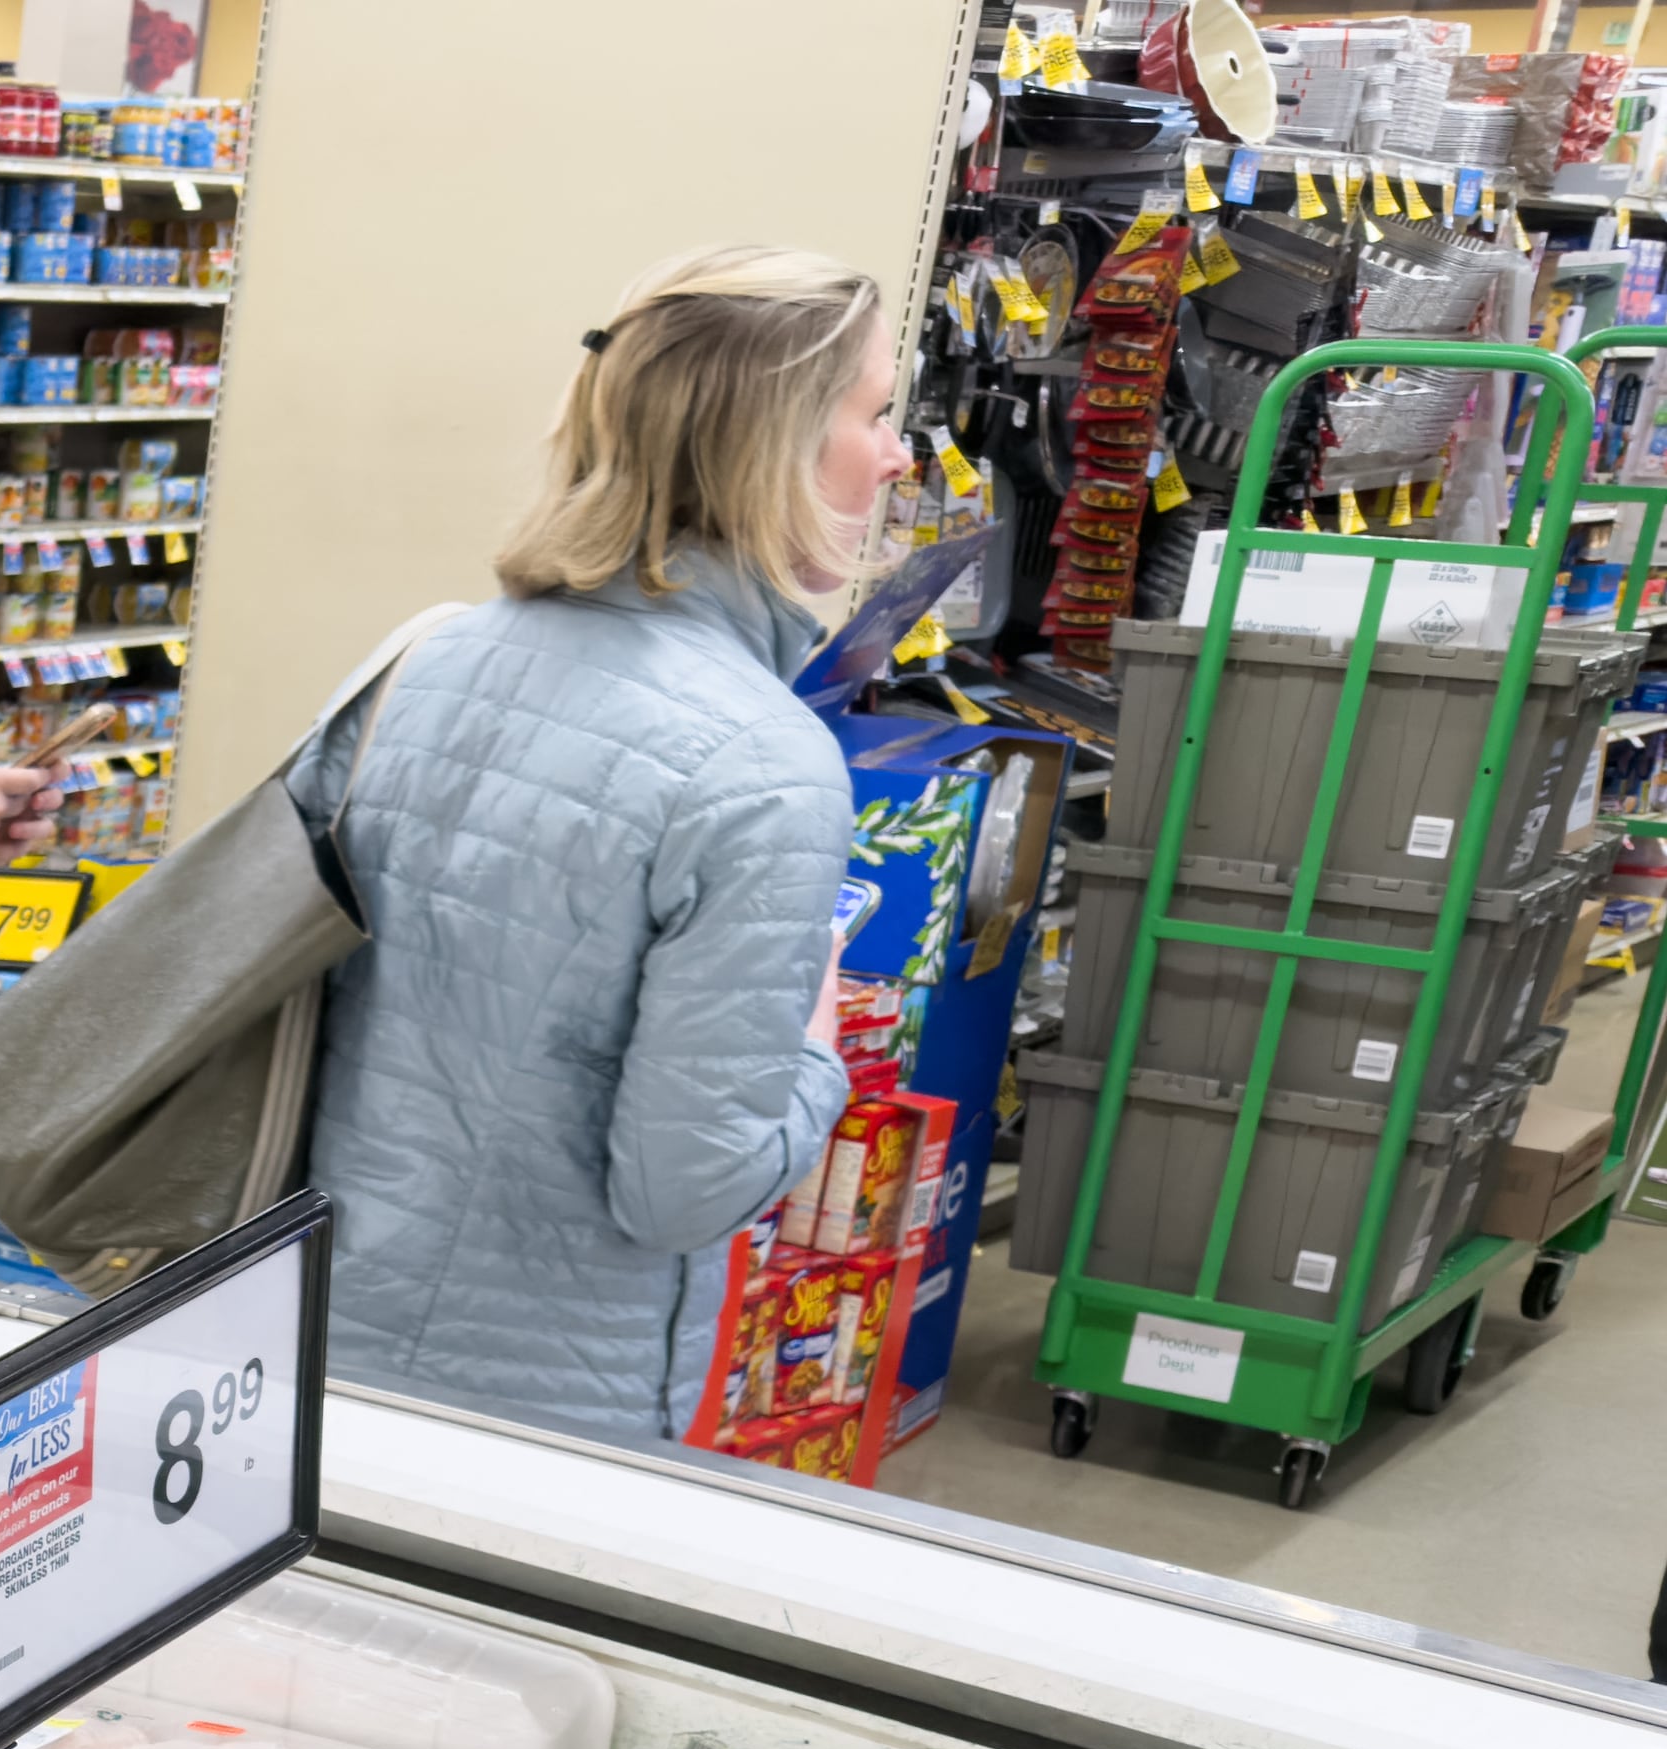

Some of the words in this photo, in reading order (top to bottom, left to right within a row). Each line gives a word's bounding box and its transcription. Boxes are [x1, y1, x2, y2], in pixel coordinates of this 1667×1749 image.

[1148, 1330, 1220, 1358] Produce
[27, 1369, 72, 1418] BEST
[6, 1452, 30, 1496] for
[30, 1418, 72, 1468] LESS
[244, 1456, 255, 1472] lb
[11, 1492, 38, 1523] More
[41, 1482, 58, 1503] on
[60, 1466, 79, 1492] our
[28, 1491, 71, 1526] Brands
[45, 1512, 85, 1547] CHICKEN
[35, 1532, 82, 1569] BONELESS
[4, 1567, 48, 1600] SKINLESS
[49, 1553, 71, 1577] THIN
